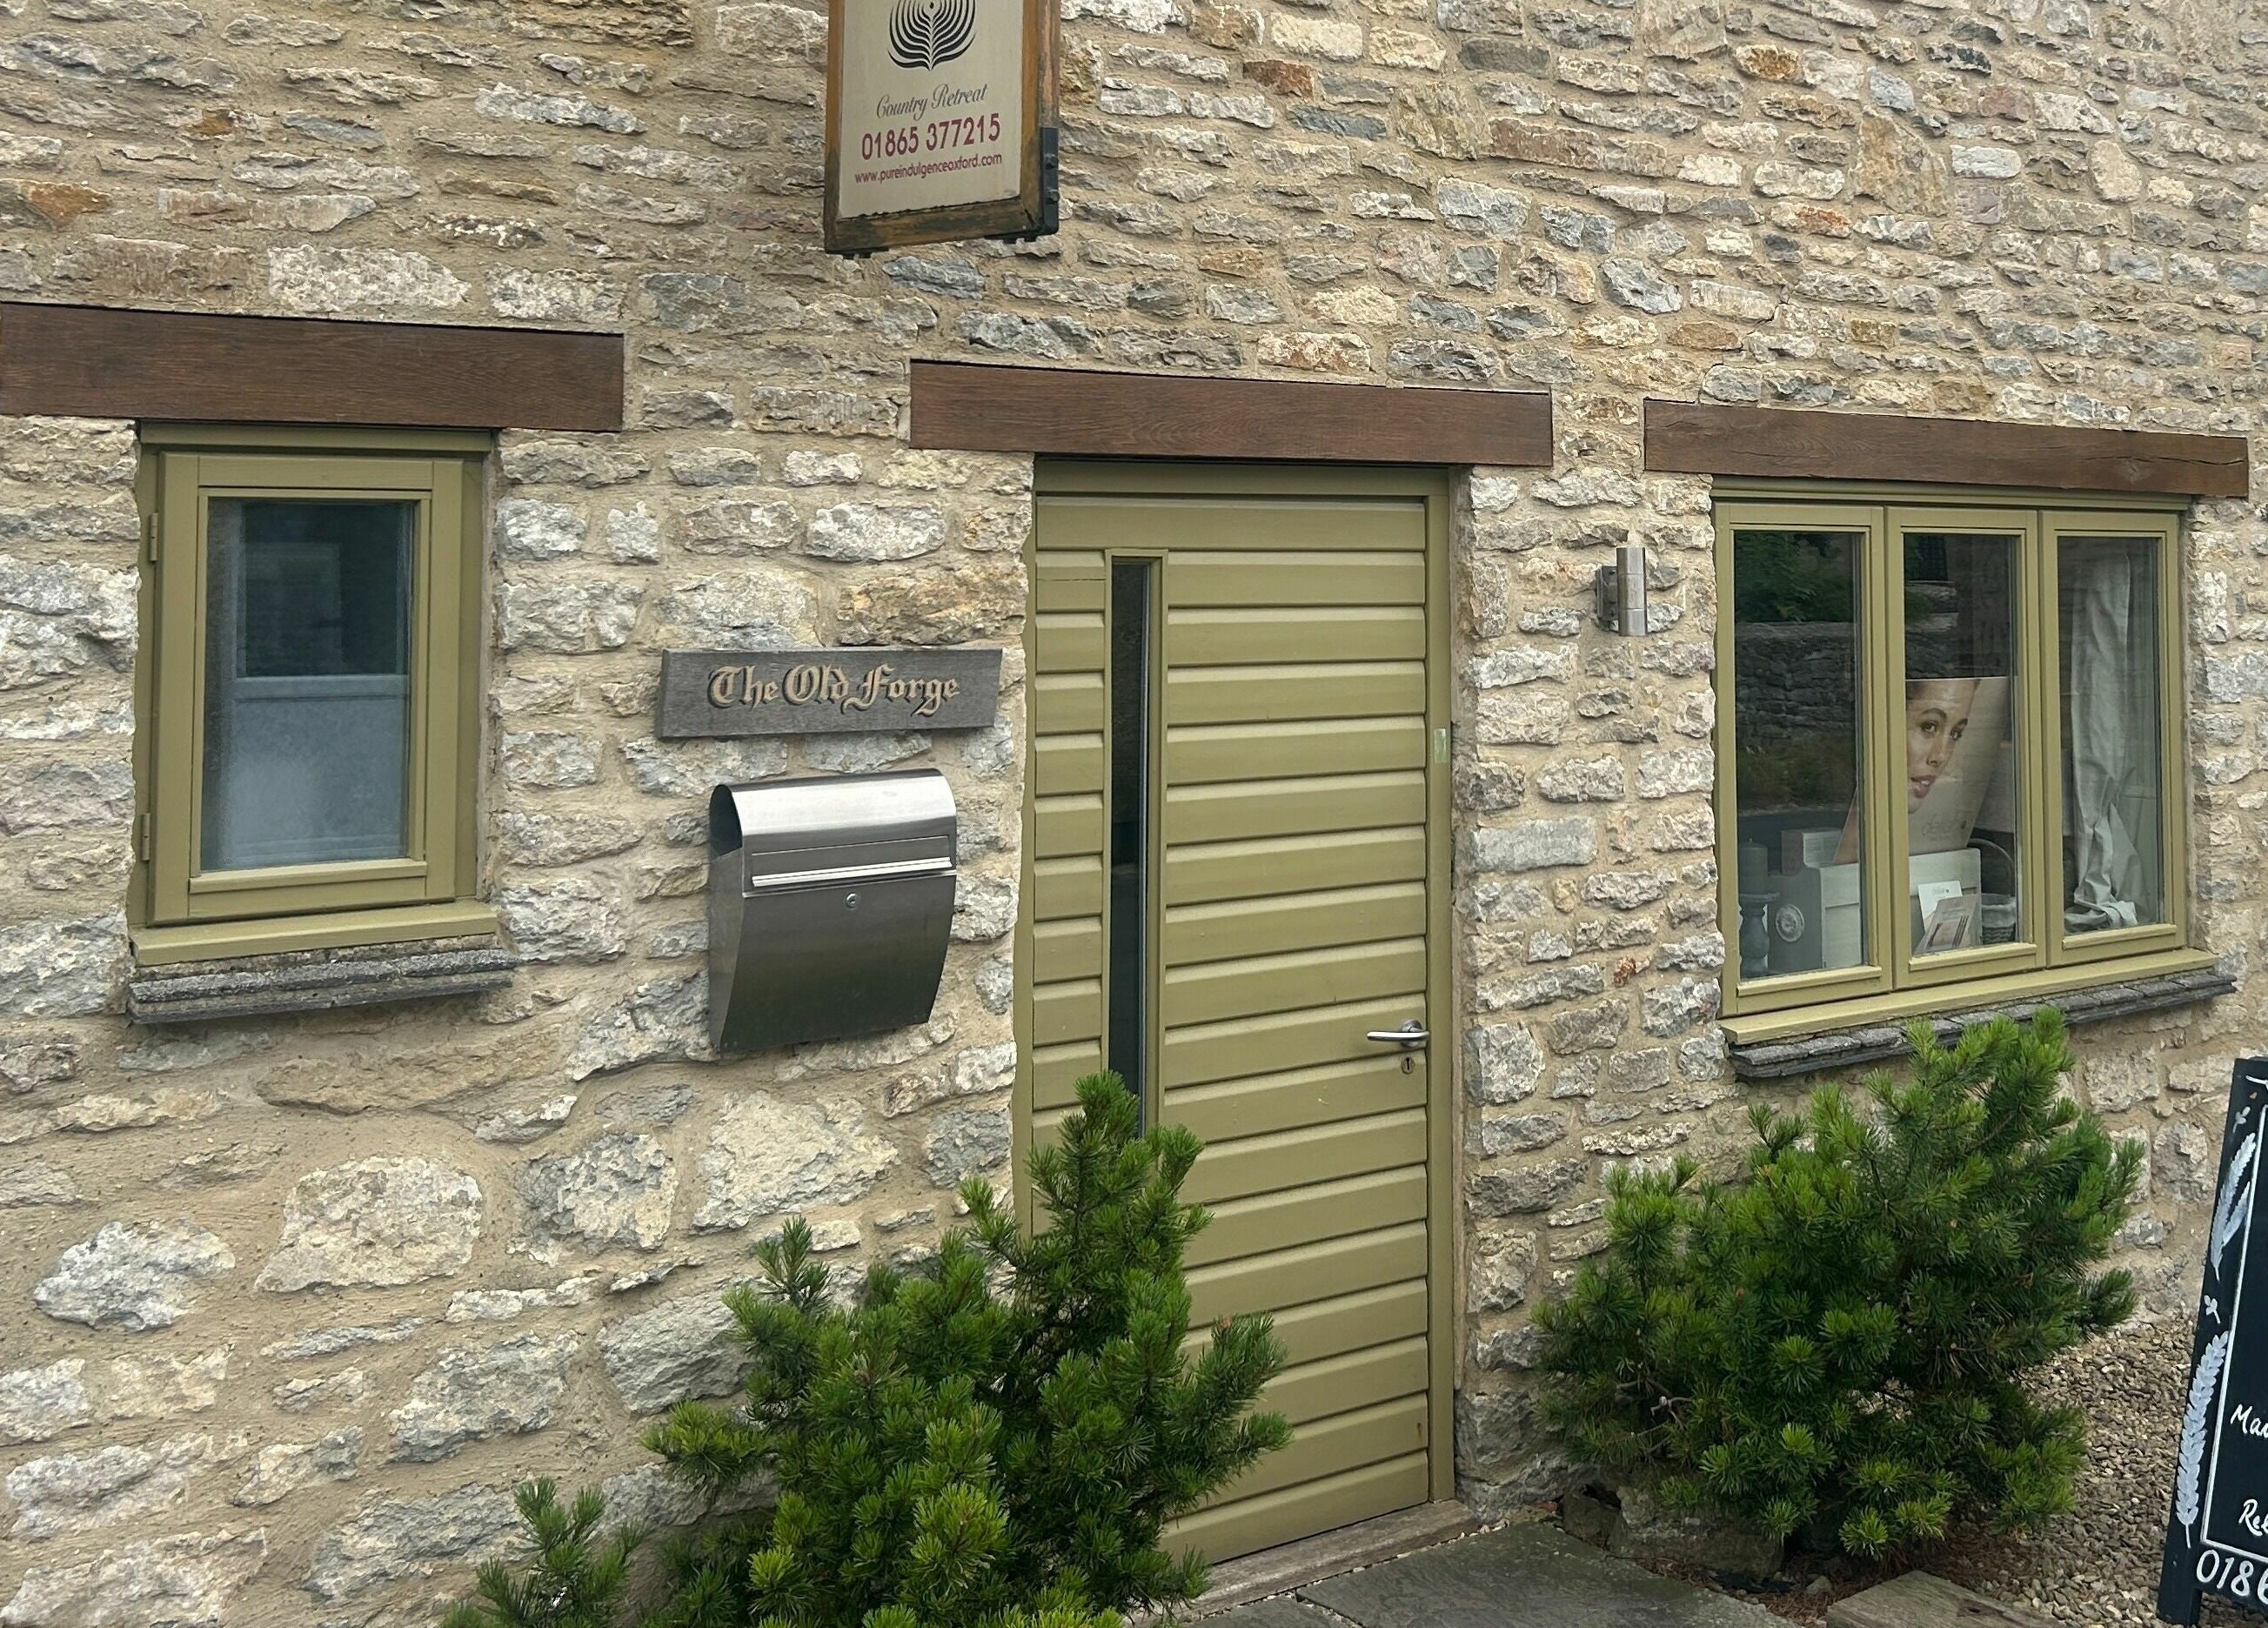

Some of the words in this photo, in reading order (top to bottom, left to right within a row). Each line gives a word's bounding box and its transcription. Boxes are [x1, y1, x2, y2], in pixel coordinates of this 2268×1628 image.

[877, 93, 928, 121] Country
[932, 84, 987, 109] Retreat
[861, 126, 919, 160] 01865
[926, 113, 1000, 151] 377215
[854, 153, 1003, 184] www.pureindulgenceoxford.com
[707, 664, 779, 710] The
[783, 663, 851, 706] Old
[840, 662, 960, 717] Forge
